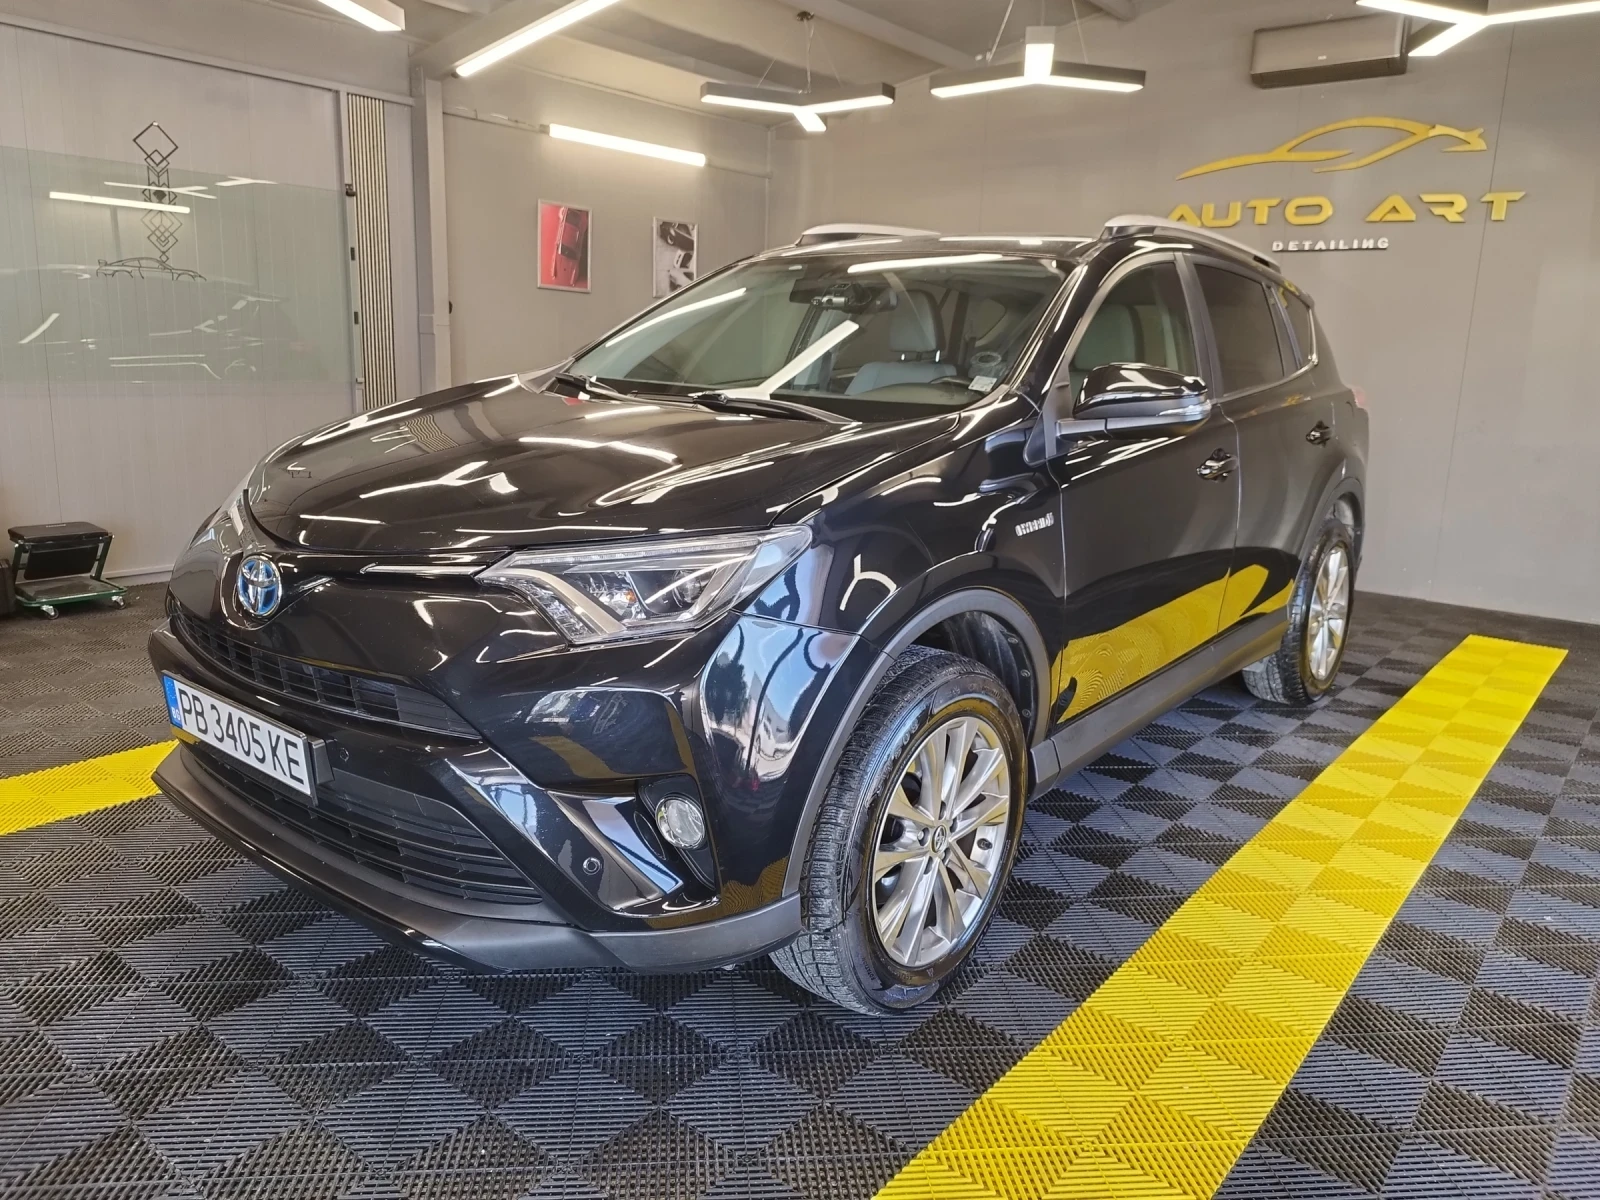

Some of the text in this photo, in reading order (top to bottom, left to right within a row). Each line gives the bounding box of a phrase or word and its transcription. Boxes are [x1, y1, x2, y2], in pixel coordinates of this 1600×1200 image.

[1168, 188, 1526, 228] AUTO ART
[1272, 237, 1389, 252] DETAILING
[171, 706, 181, 721] BG
[178, 687, 304, 785] PB 3405 KE
